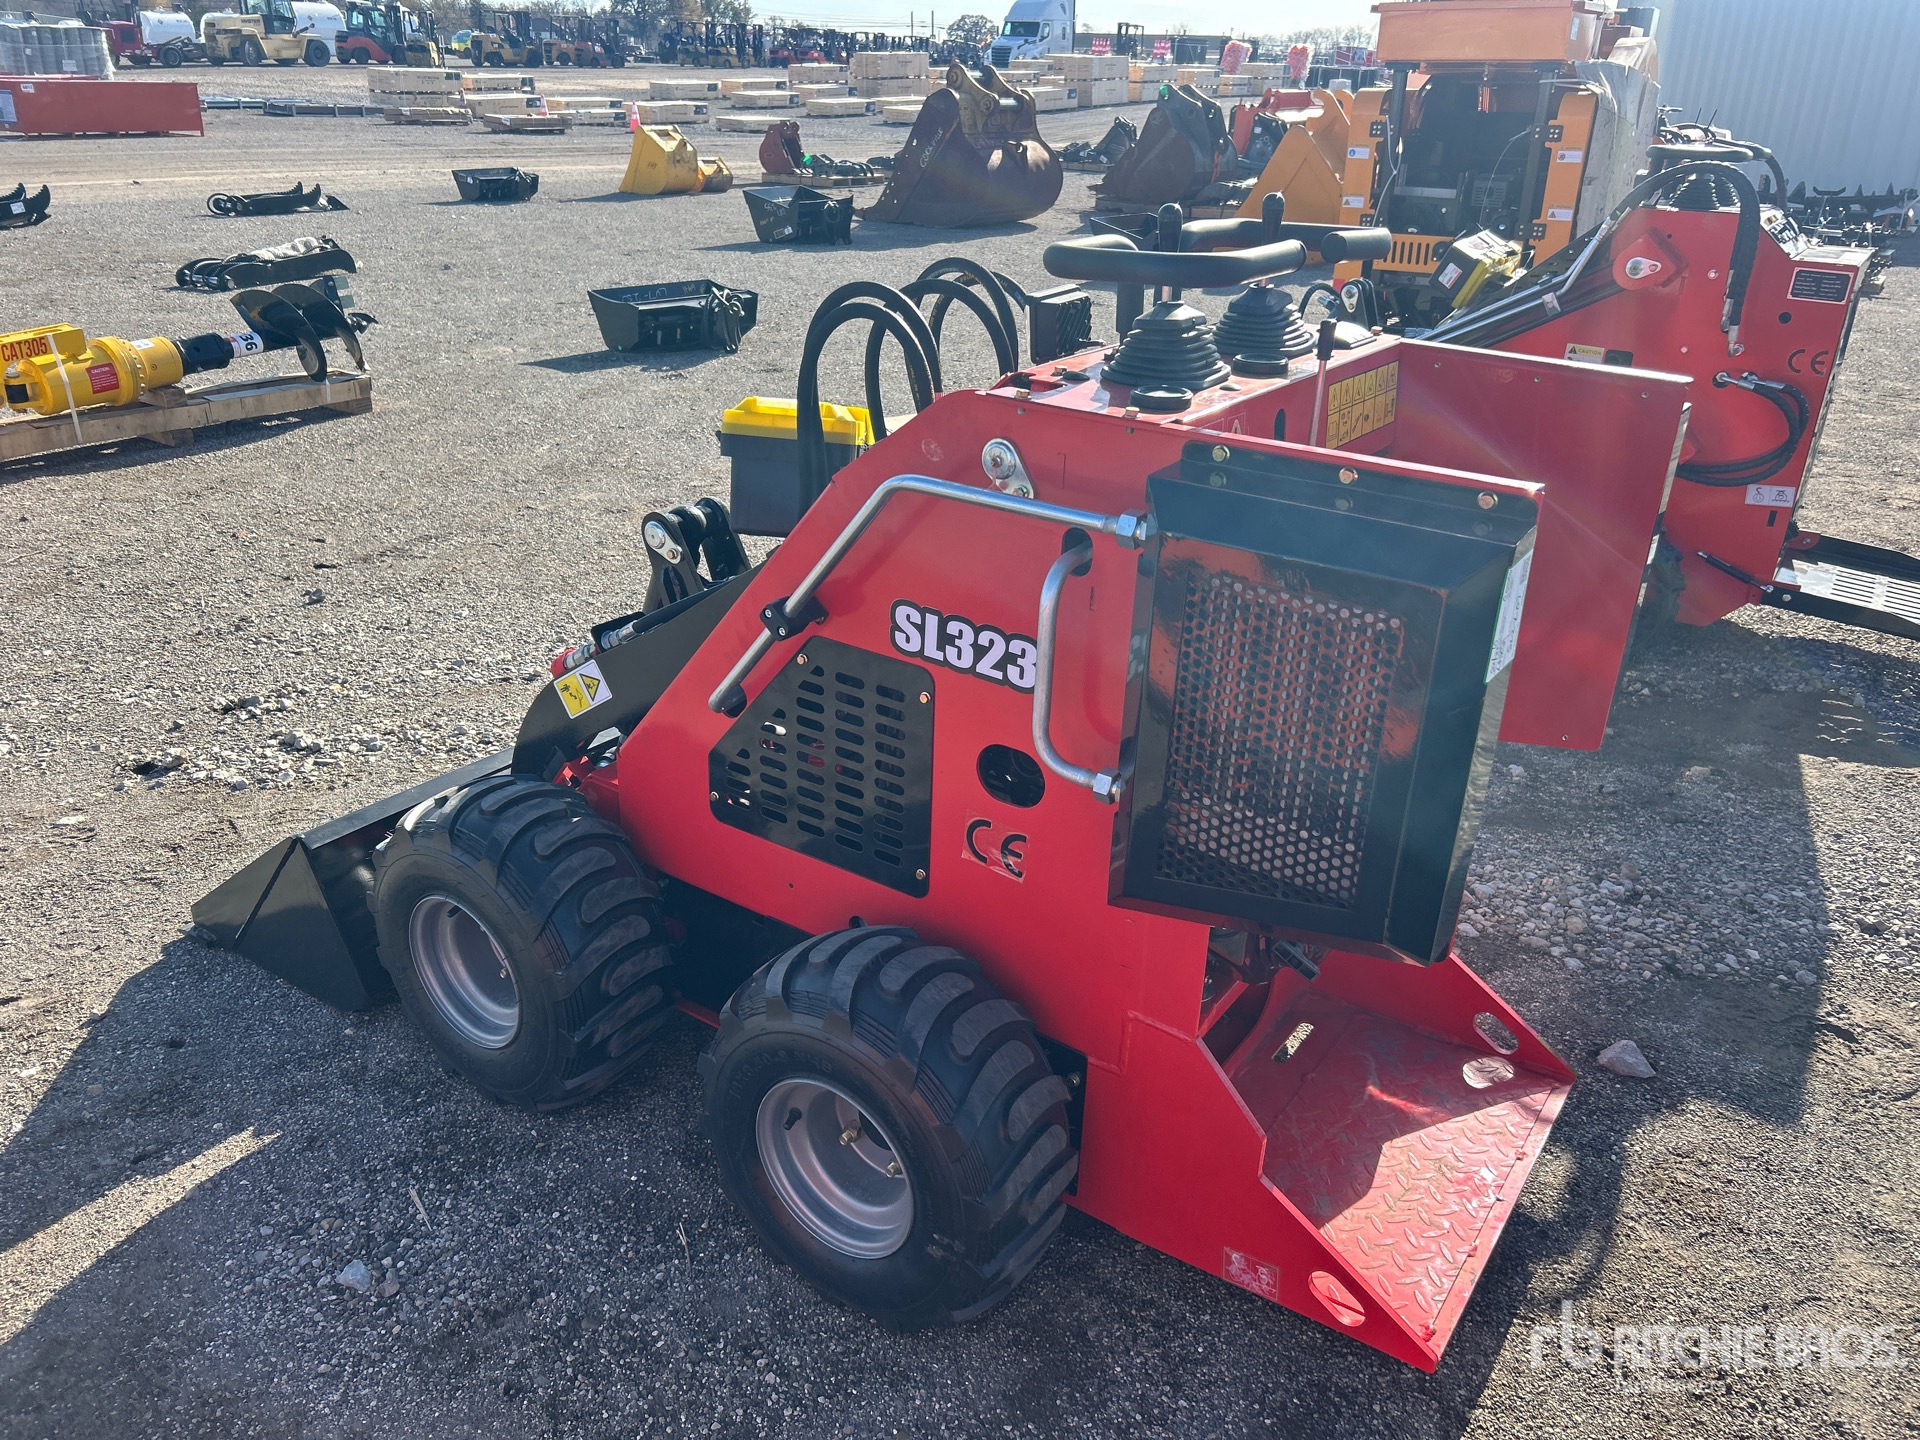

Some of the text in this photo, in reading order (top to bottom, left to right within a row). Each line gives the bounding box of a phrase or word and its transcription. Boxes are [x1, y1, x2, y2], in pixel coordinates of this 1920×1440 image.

[1, 337, 48, 362] CAT305
[239, 333, 258, 351] 36
[1578, 348, 1602, 356] CAUTION
[1787, 348, 1829, 376] CE
[893, 603, 1038, 690] SL323
[966, 819, 1027, 878] CE
